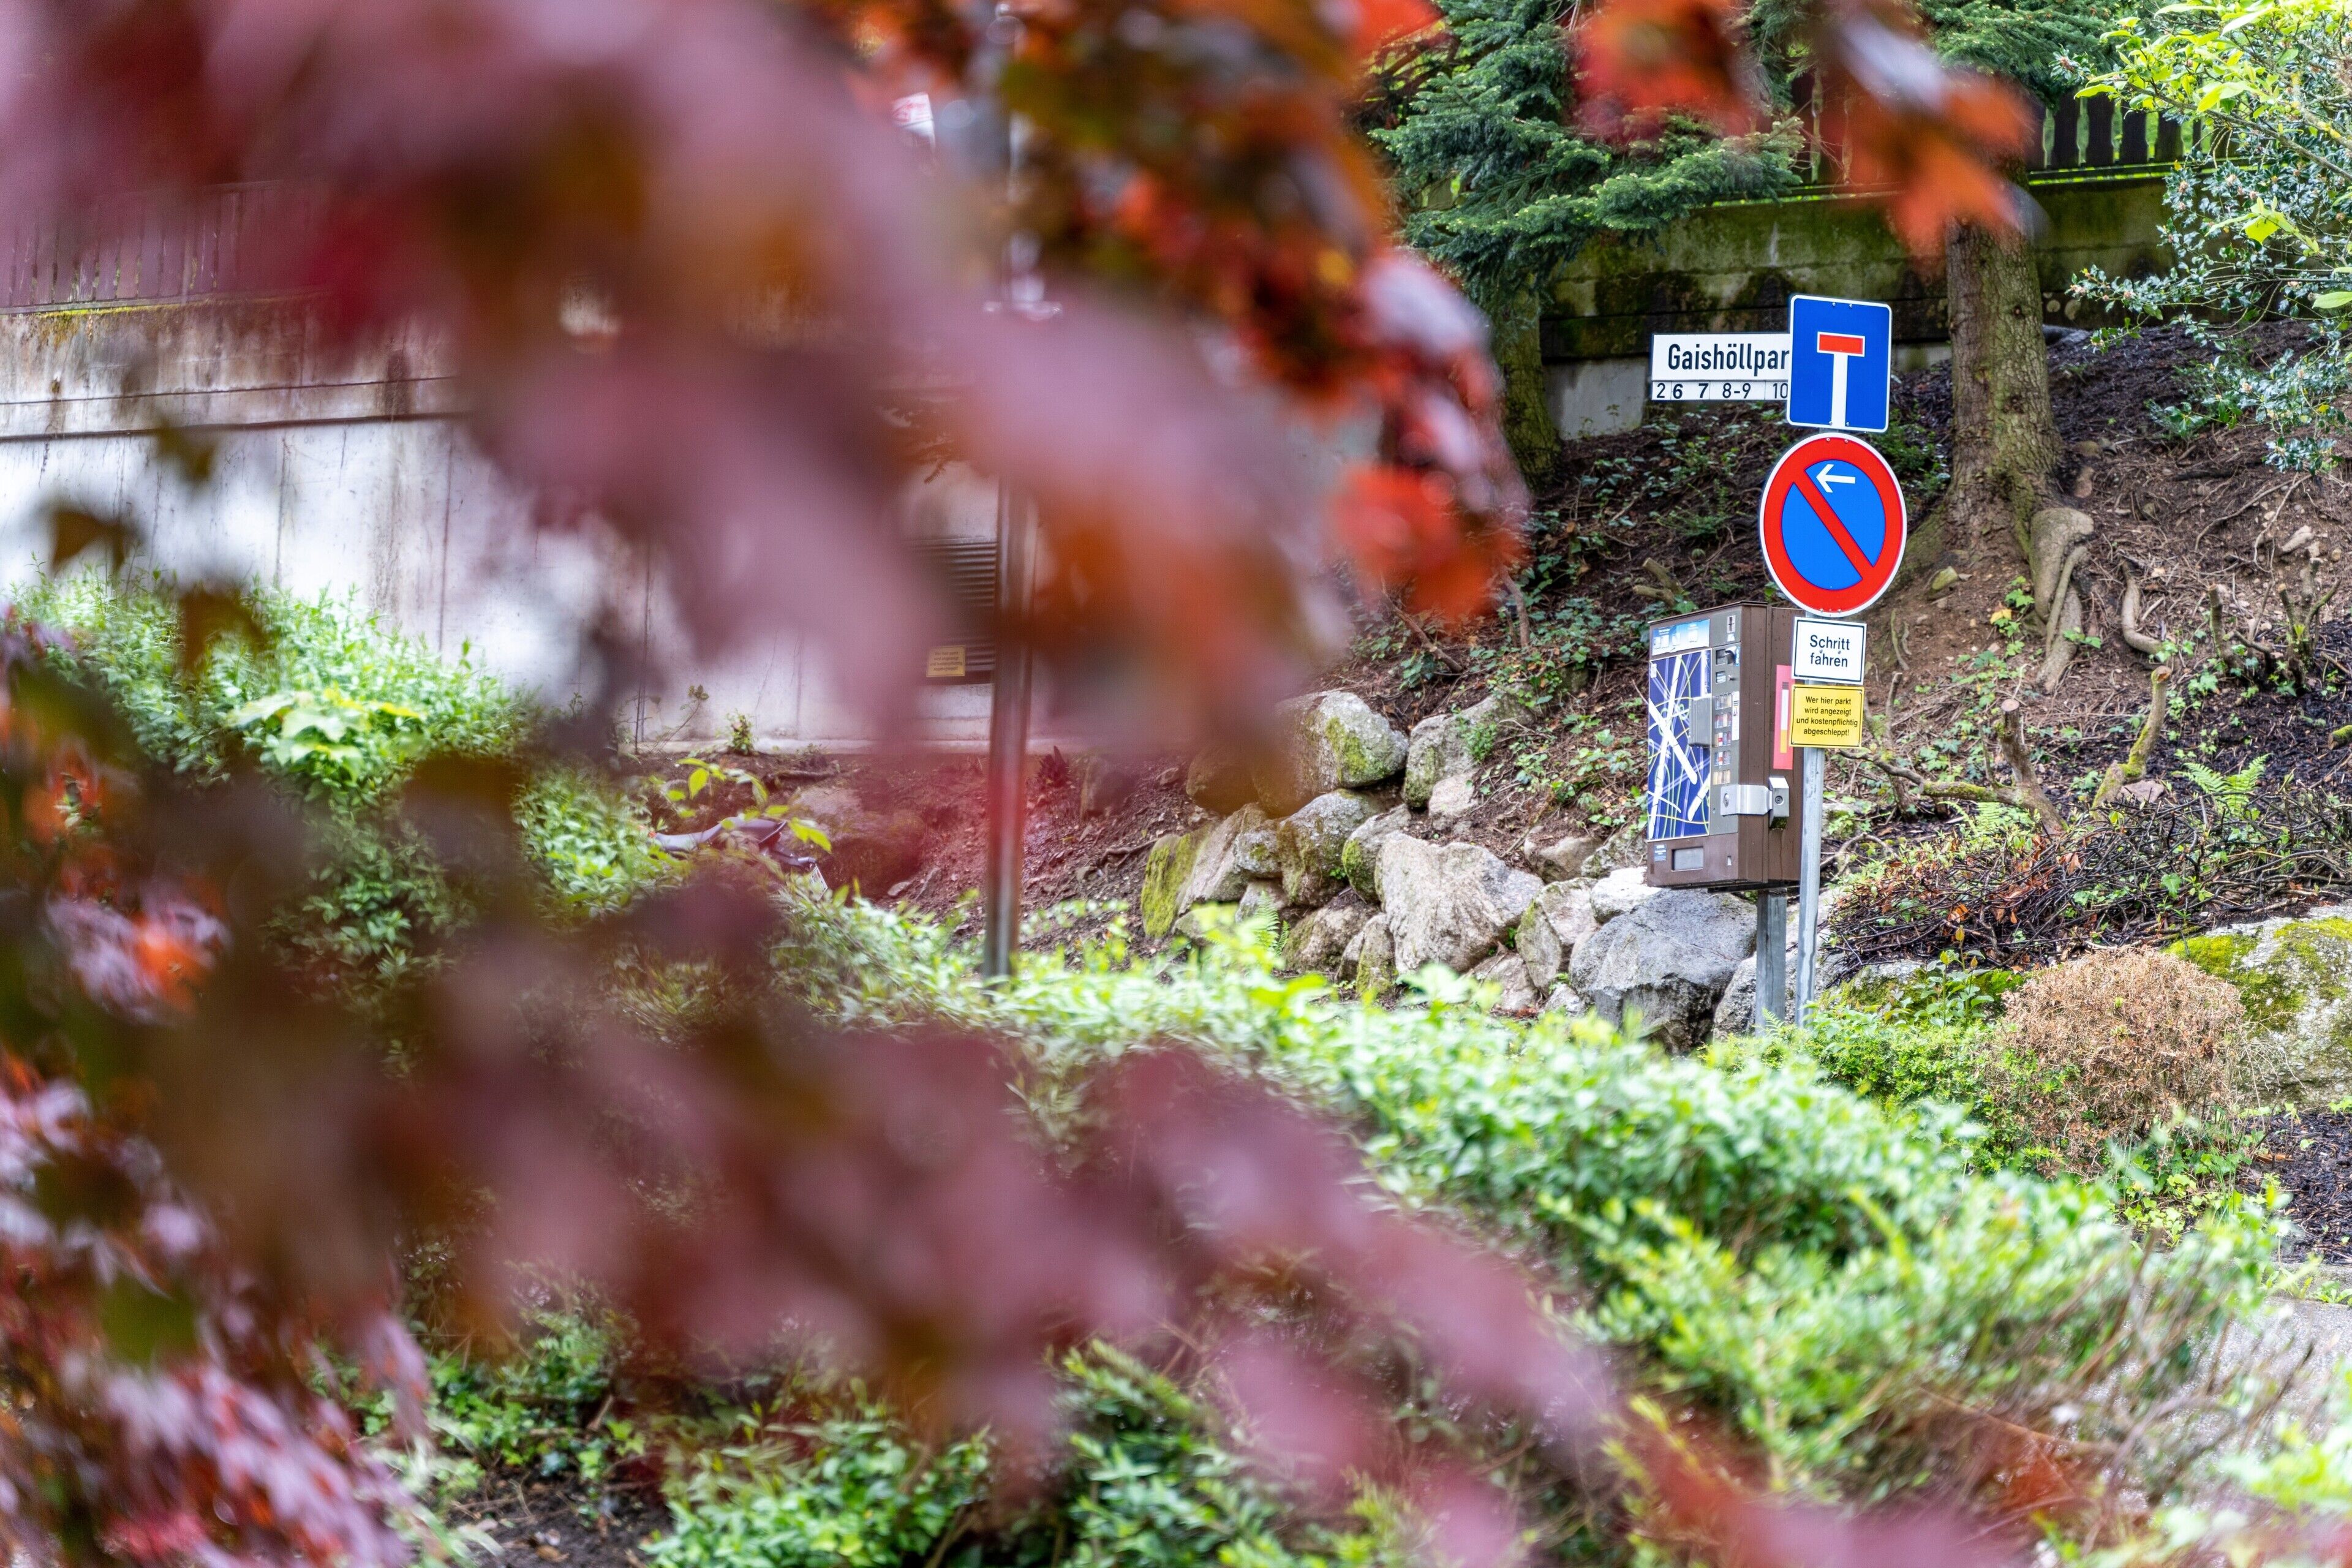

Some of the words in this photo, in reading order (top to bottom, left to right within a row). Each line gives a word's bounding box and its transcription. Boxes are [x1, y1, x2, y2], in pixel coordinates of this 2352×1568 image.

[1668, 343, 1790, 377] Gaishöllpar
[1656, 382, 1665, 399] 2
[1673, 383, 1683, 399] 6
[1698, 382, 1709, 399] 7
[1722, 382, 1751, 399] 8-9
[1809, 635, 1850, 650] Schritt
[1810, 652, 1848, 668] fahren
[1835, 698, 1852, 706] parkt
[1820, 707, 1852, 716] angezeigt
[1811, 718, 1858, 727] kostenpflichtig
[1803, 728, 1850, 737] abgeschleppt!
